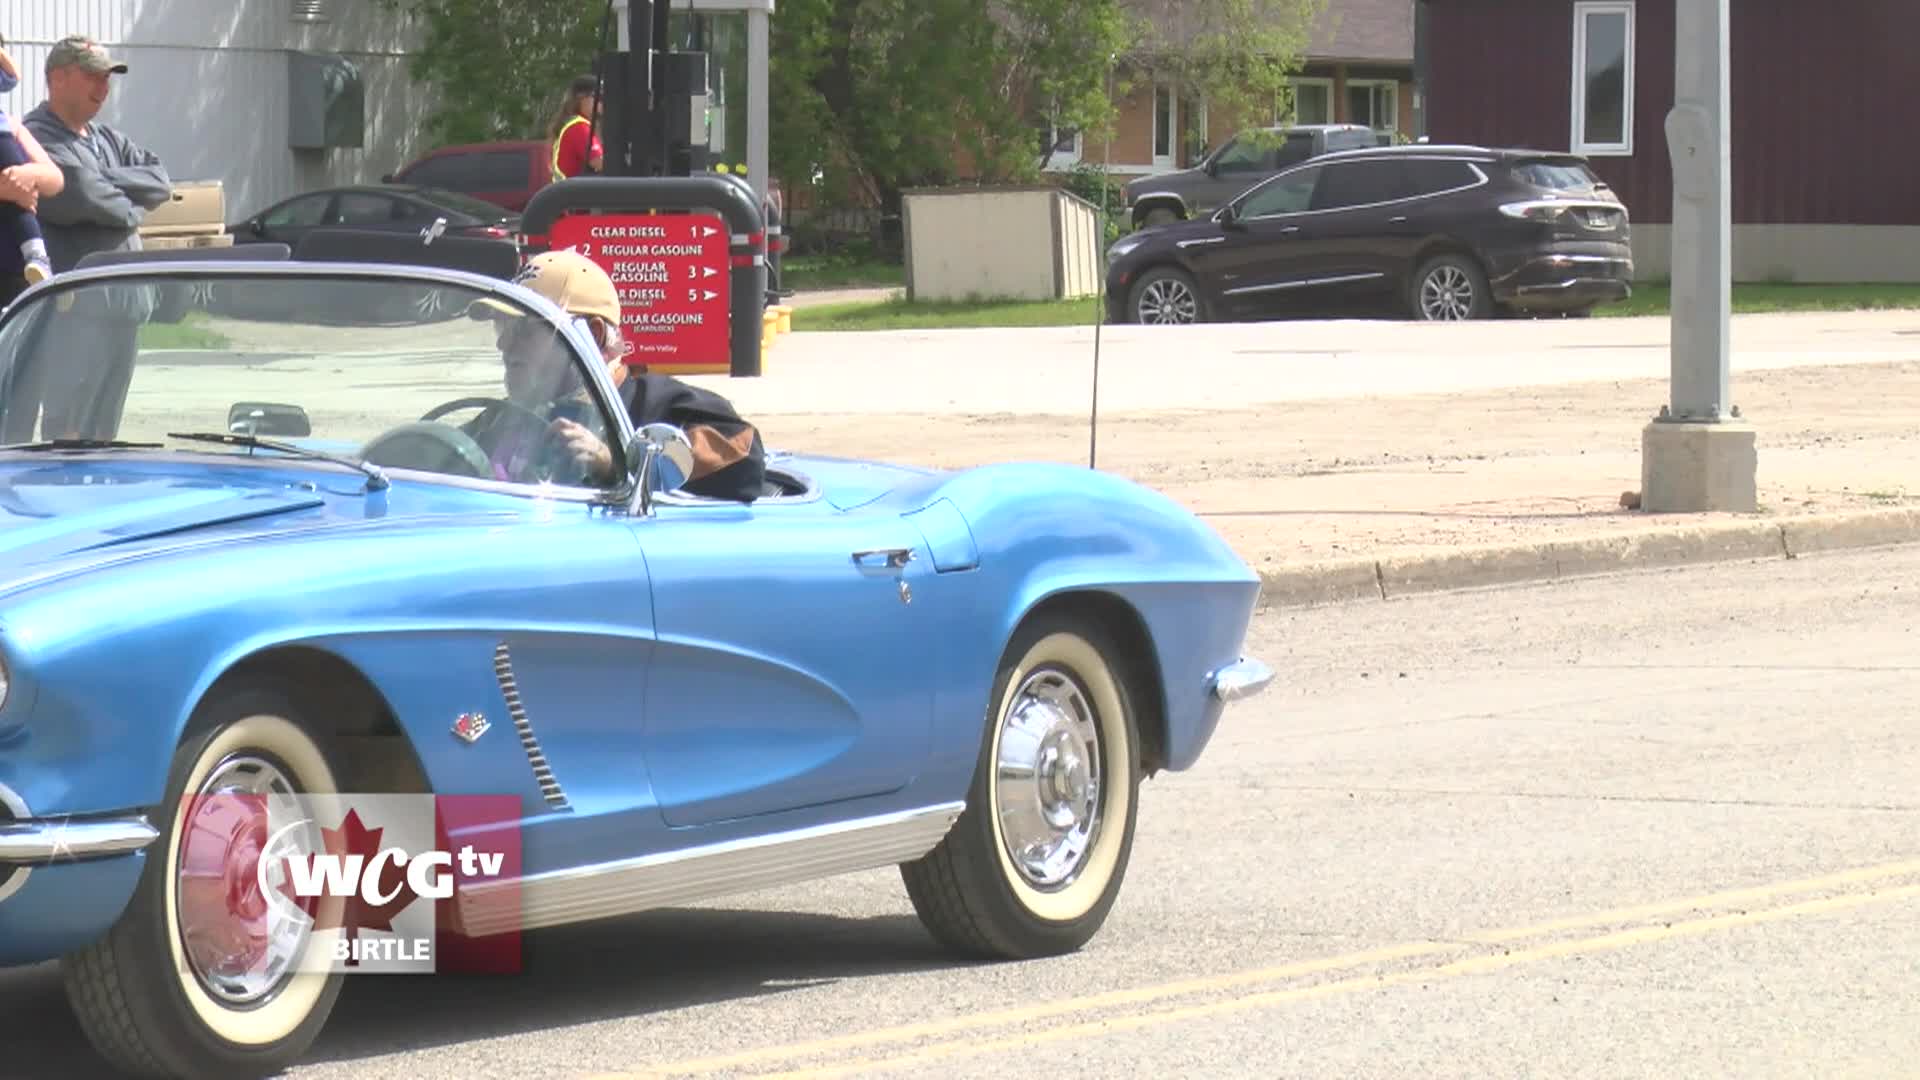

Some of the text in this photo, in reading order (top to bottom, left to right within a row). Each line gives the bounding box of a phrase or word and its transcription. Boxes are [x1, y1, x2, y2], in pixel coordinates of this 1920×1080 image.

[591, 226, 697, 238] CLEAR DIESEL 1
[583, 243, 703, 257] 2 REGULAR GASOLINE
[613, 262, 666, 272] REGULAR
[688, 266, 697, 279] 3
[611, 272, 669, 283] GASOLINE
[629, 289, 667, 300] DIESEL
[688, 289, 698, 301] 5
[621, 313, 704, 325] ULAR GASOLINE
[656, 344, 678, 354] Valley
